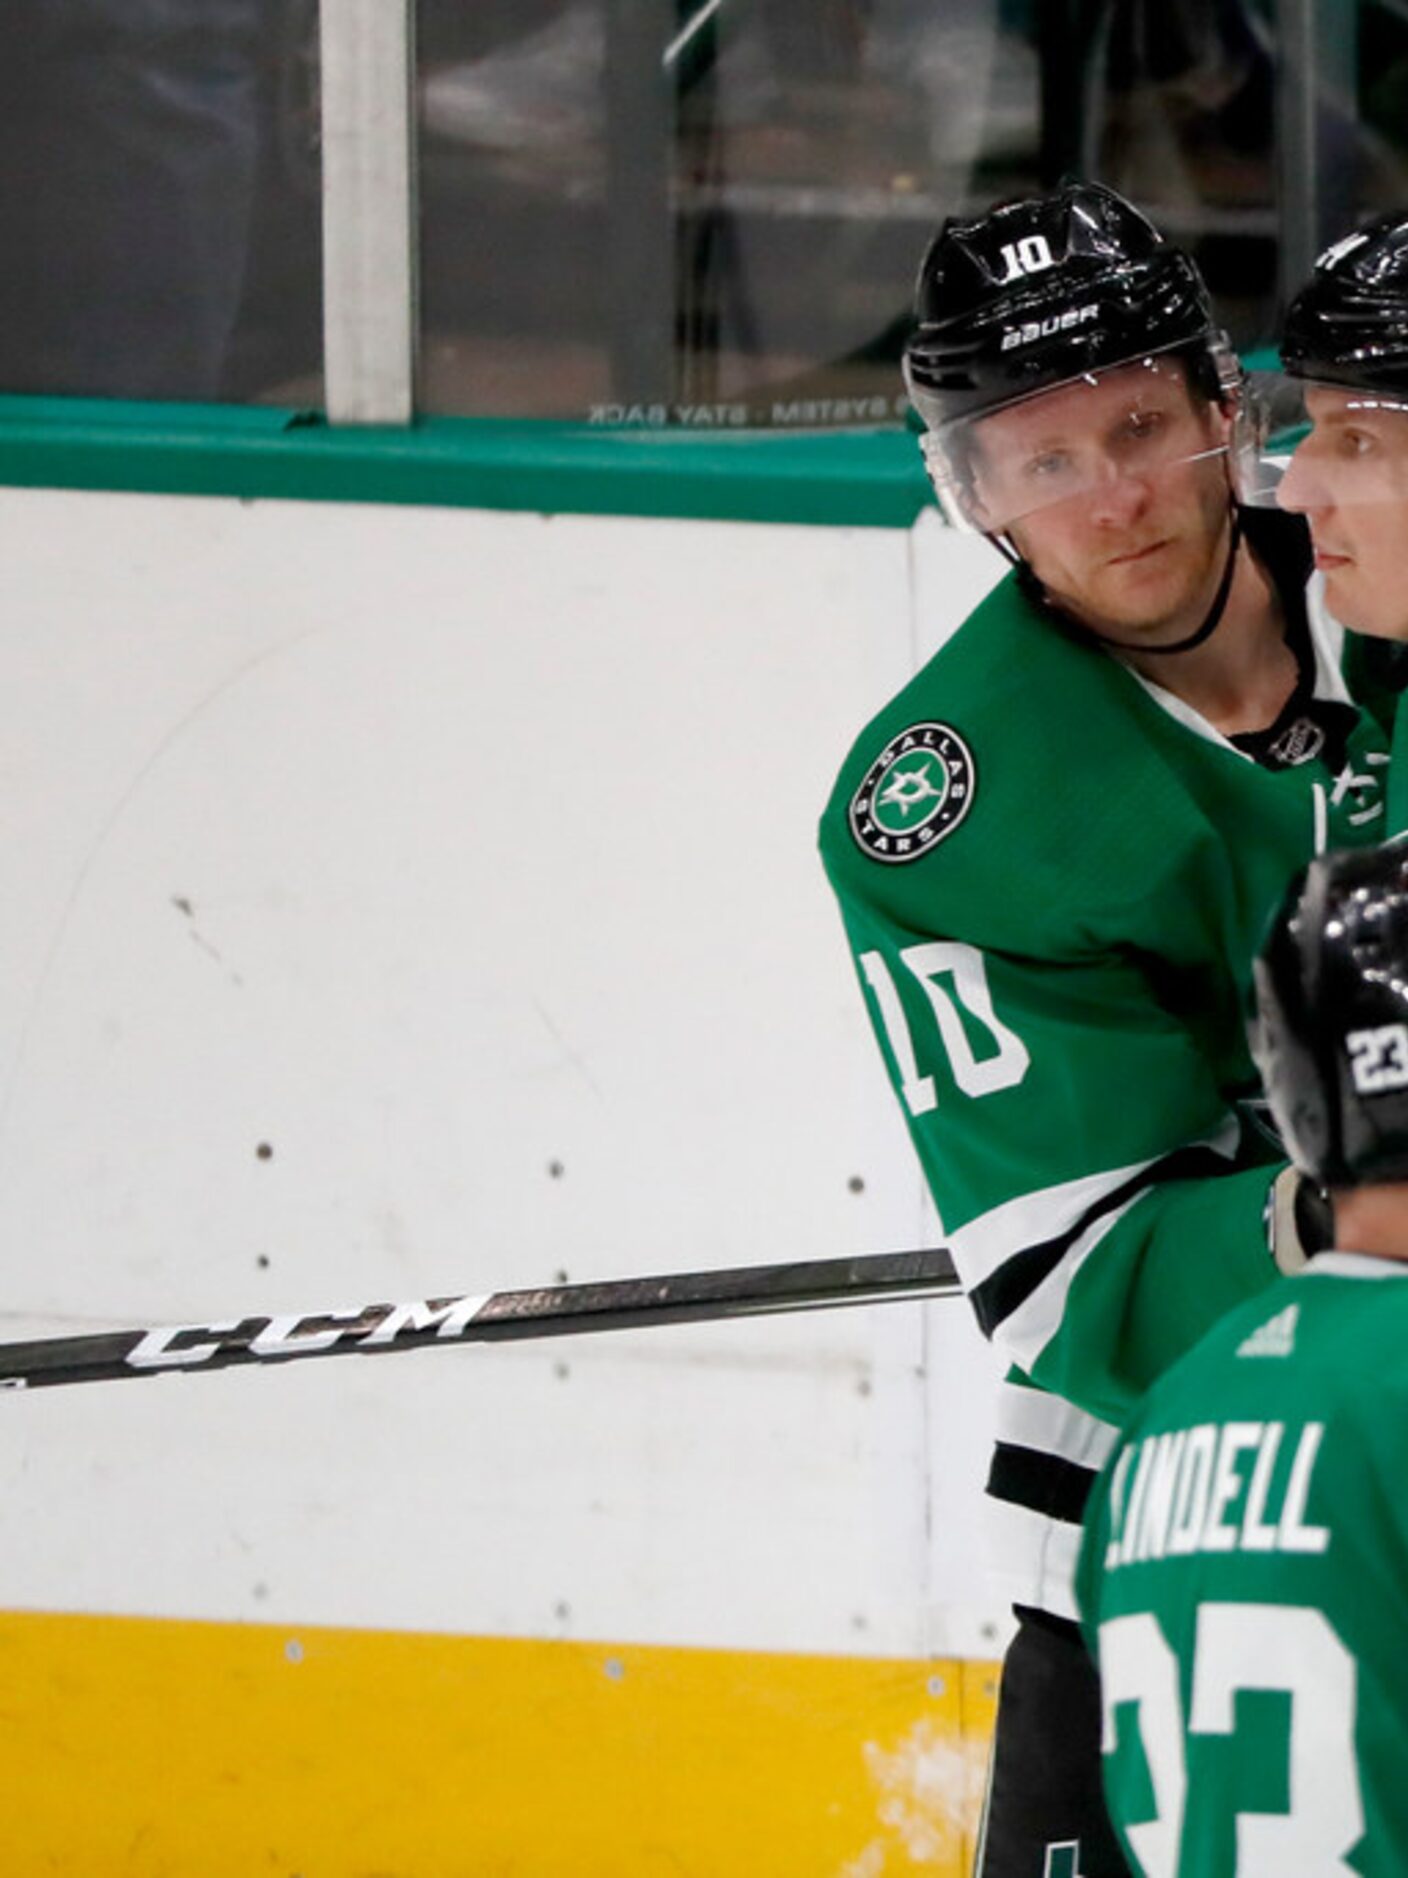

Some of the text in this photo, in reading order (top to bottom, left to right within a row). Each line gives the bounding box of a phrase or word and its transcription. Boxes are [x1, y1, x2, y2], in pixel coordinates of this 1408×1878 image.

[1000, 235, 1054, 283] 10
[879, 731, 966, 799] DALLAS
[856, 798, 934, 852] STARS
[859, 941, 1031, 1116] 10
[124, 1294, 499, 1368] CCM
[1104, 1422, 1330, 1572] LINDELL
